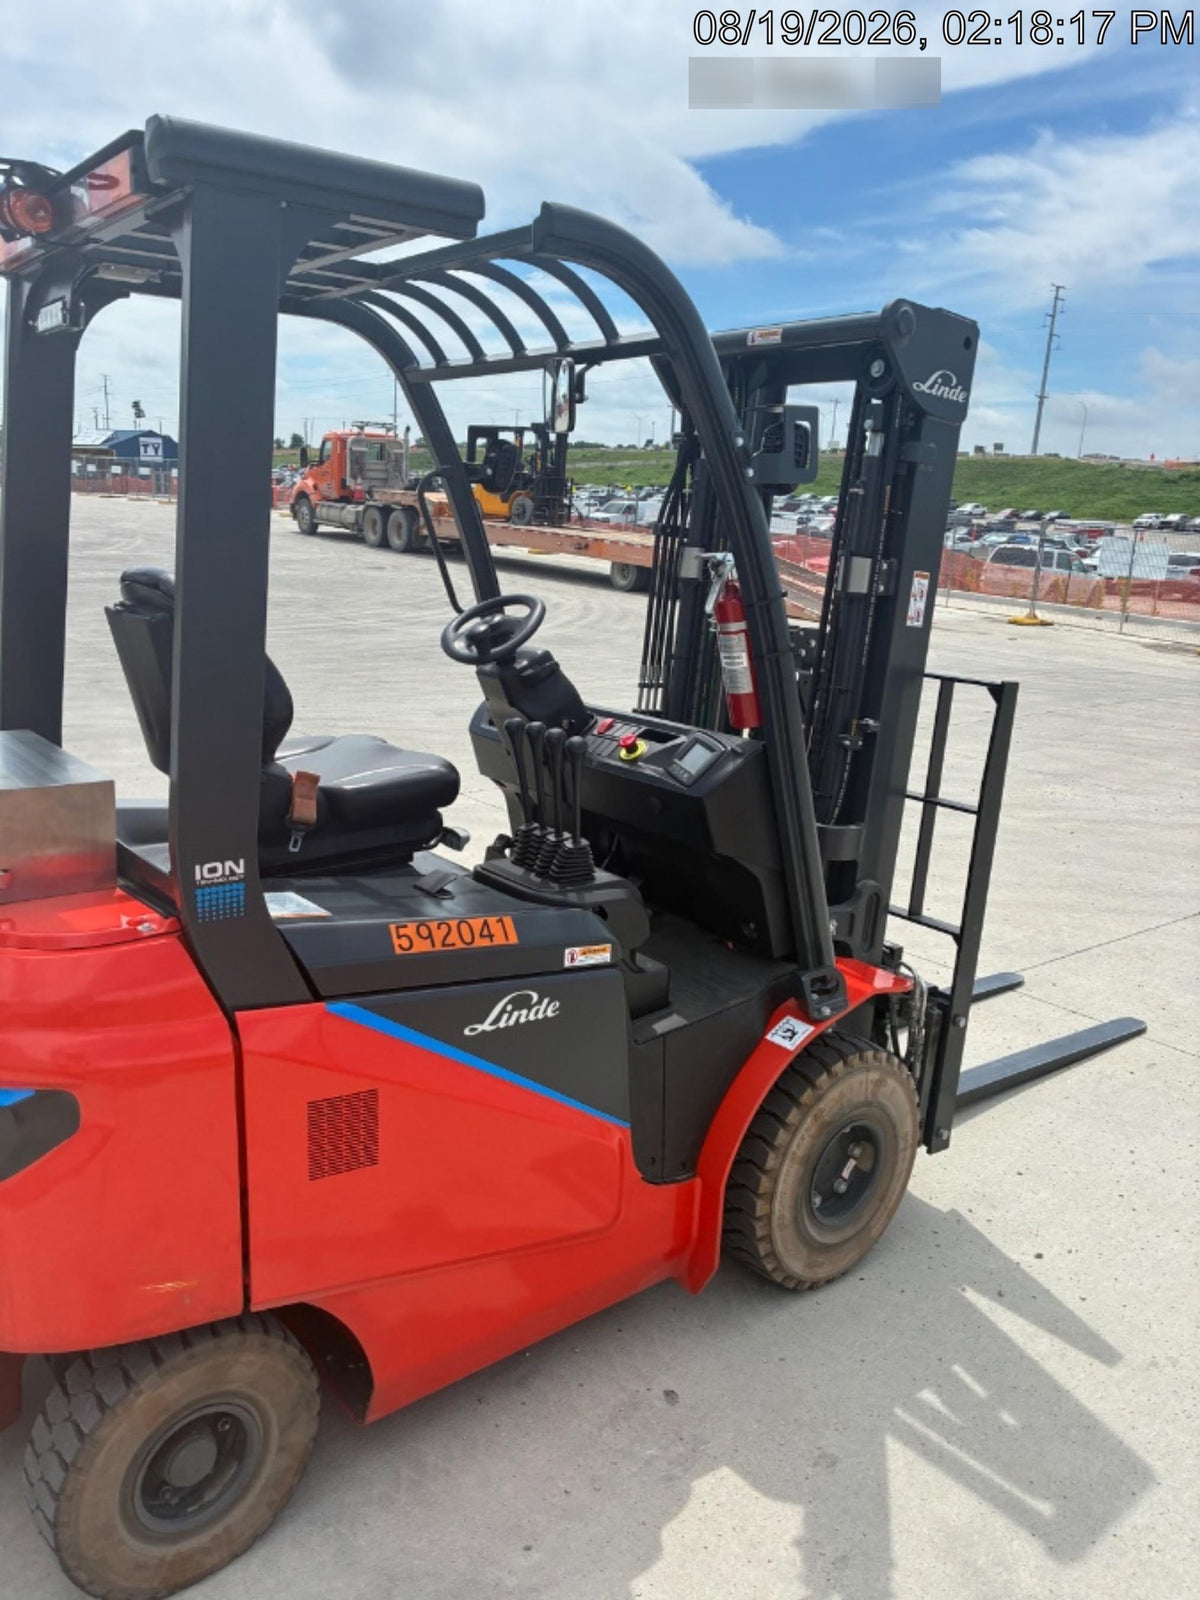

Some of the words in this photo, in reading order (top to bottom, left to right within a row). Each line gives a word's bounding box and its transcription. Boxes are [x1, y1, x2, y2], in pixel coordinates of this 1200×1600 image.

[912, 369, 968, 403] Linde
[195, 858, 245, 881] ION
[395, 917, 510, 952] 592041
[463, 990, 560, 1036] Linde
